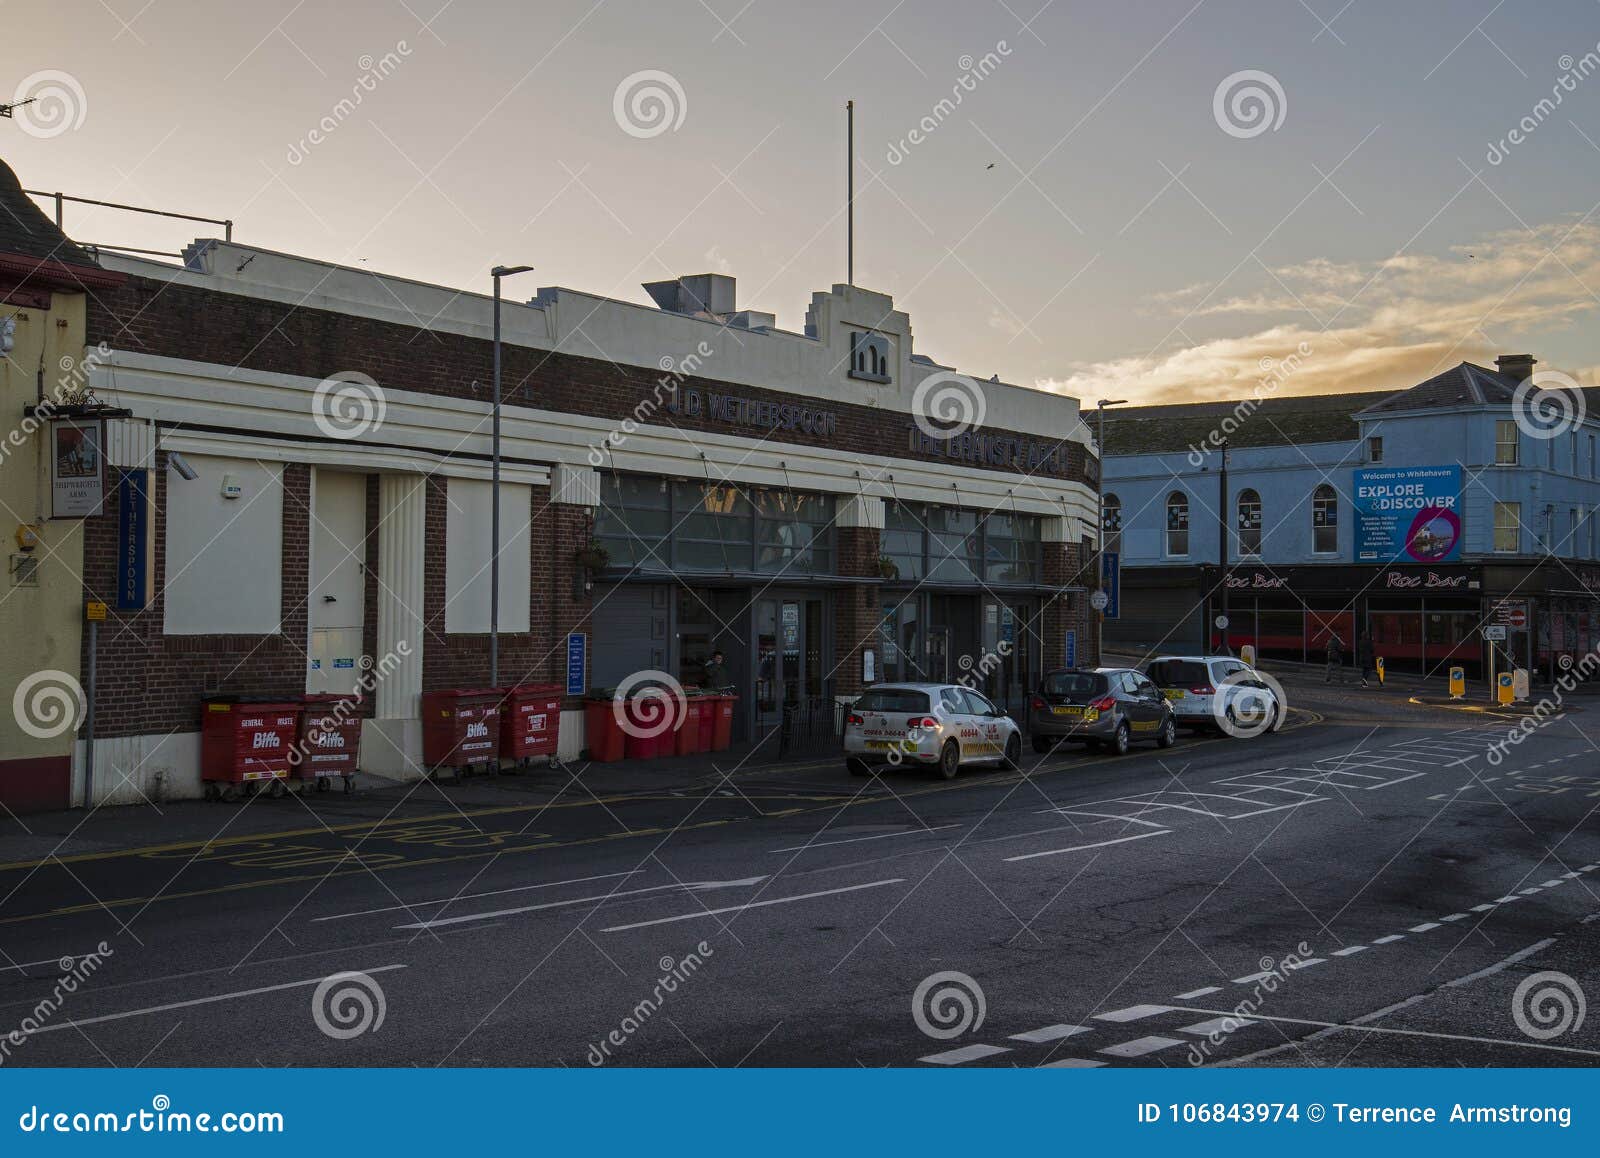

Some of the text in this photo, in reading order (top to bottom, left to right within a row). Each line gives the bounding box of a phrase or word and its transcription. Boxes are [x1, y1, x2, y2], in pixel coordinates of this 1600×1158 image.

[686, 389, 701, 416] D
[708, 392, 836, 434] WETHERSPOON
[1362, 469, 1451, 480] Welcome to Whitehaven
[1358, 483, 1424, 498] EXPLORE
[127, 478, 138, 601] WETHERSPOON
[1252, 573, 1288, 588] Bar
[1386, 571, 1466, 588] Roc Bar
[252, 731, 280, 749] Biffa
